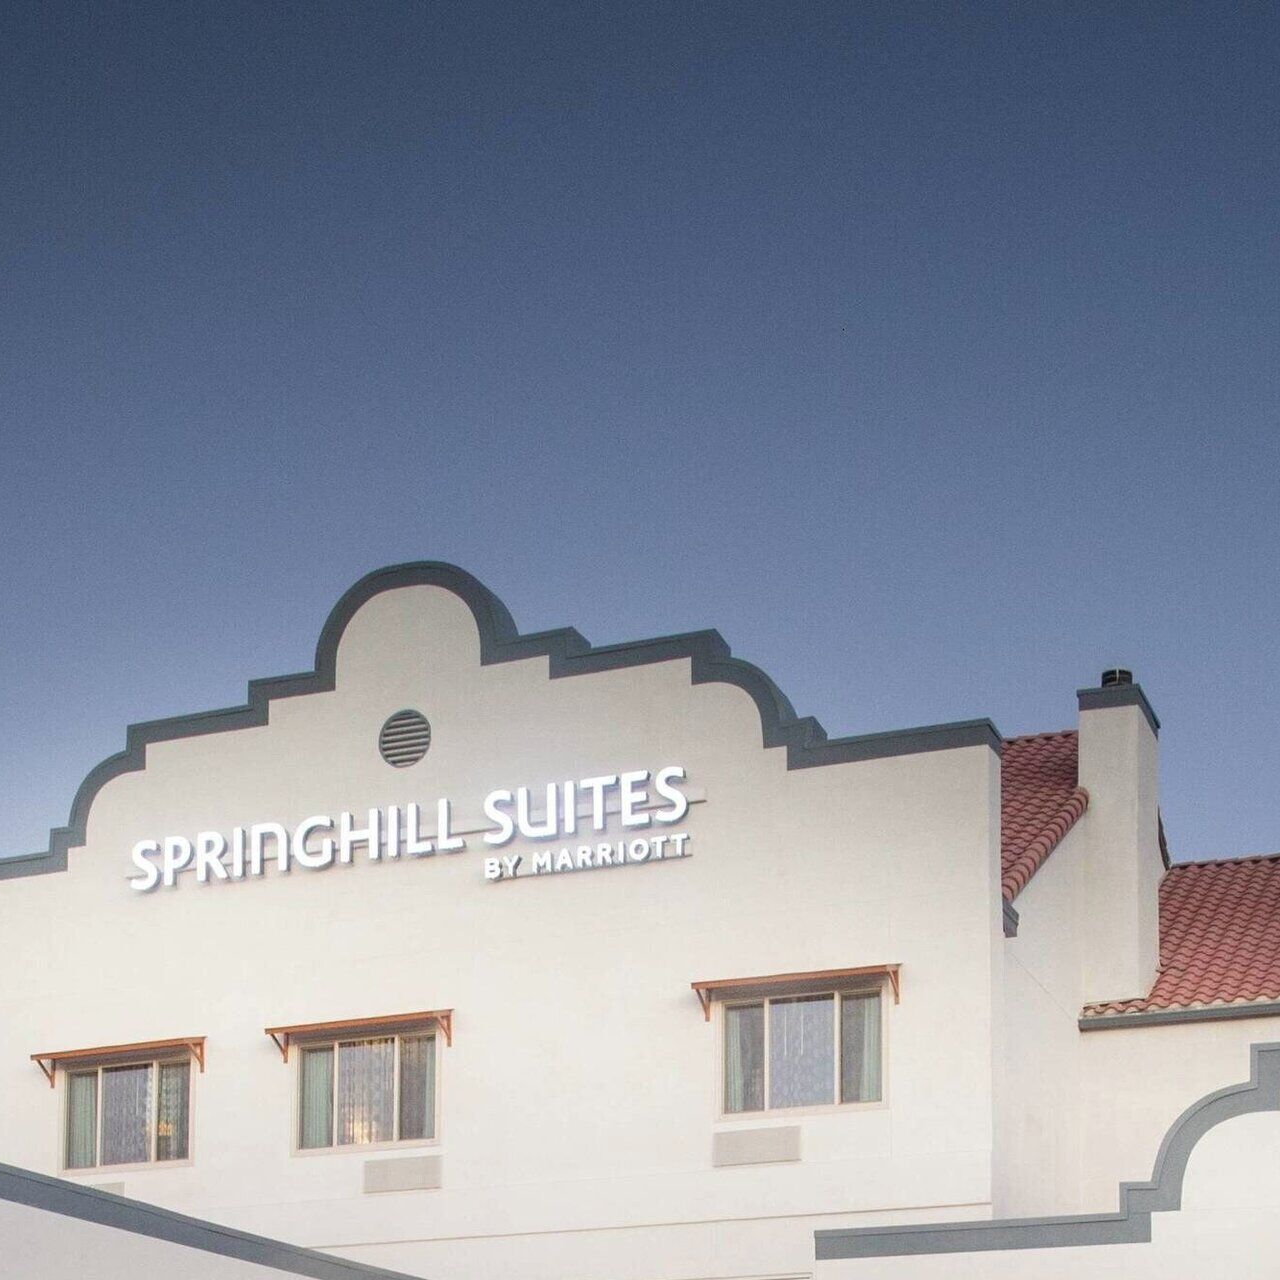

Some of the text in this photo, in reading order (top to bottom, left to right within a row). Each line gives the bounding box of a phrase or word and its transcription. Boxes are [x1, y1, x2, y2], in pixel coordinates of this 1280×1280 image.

[130, 766, 688, 891] SPRINGHILL SUITES
[484, 833, 689, 880] BY MARRIOTT
